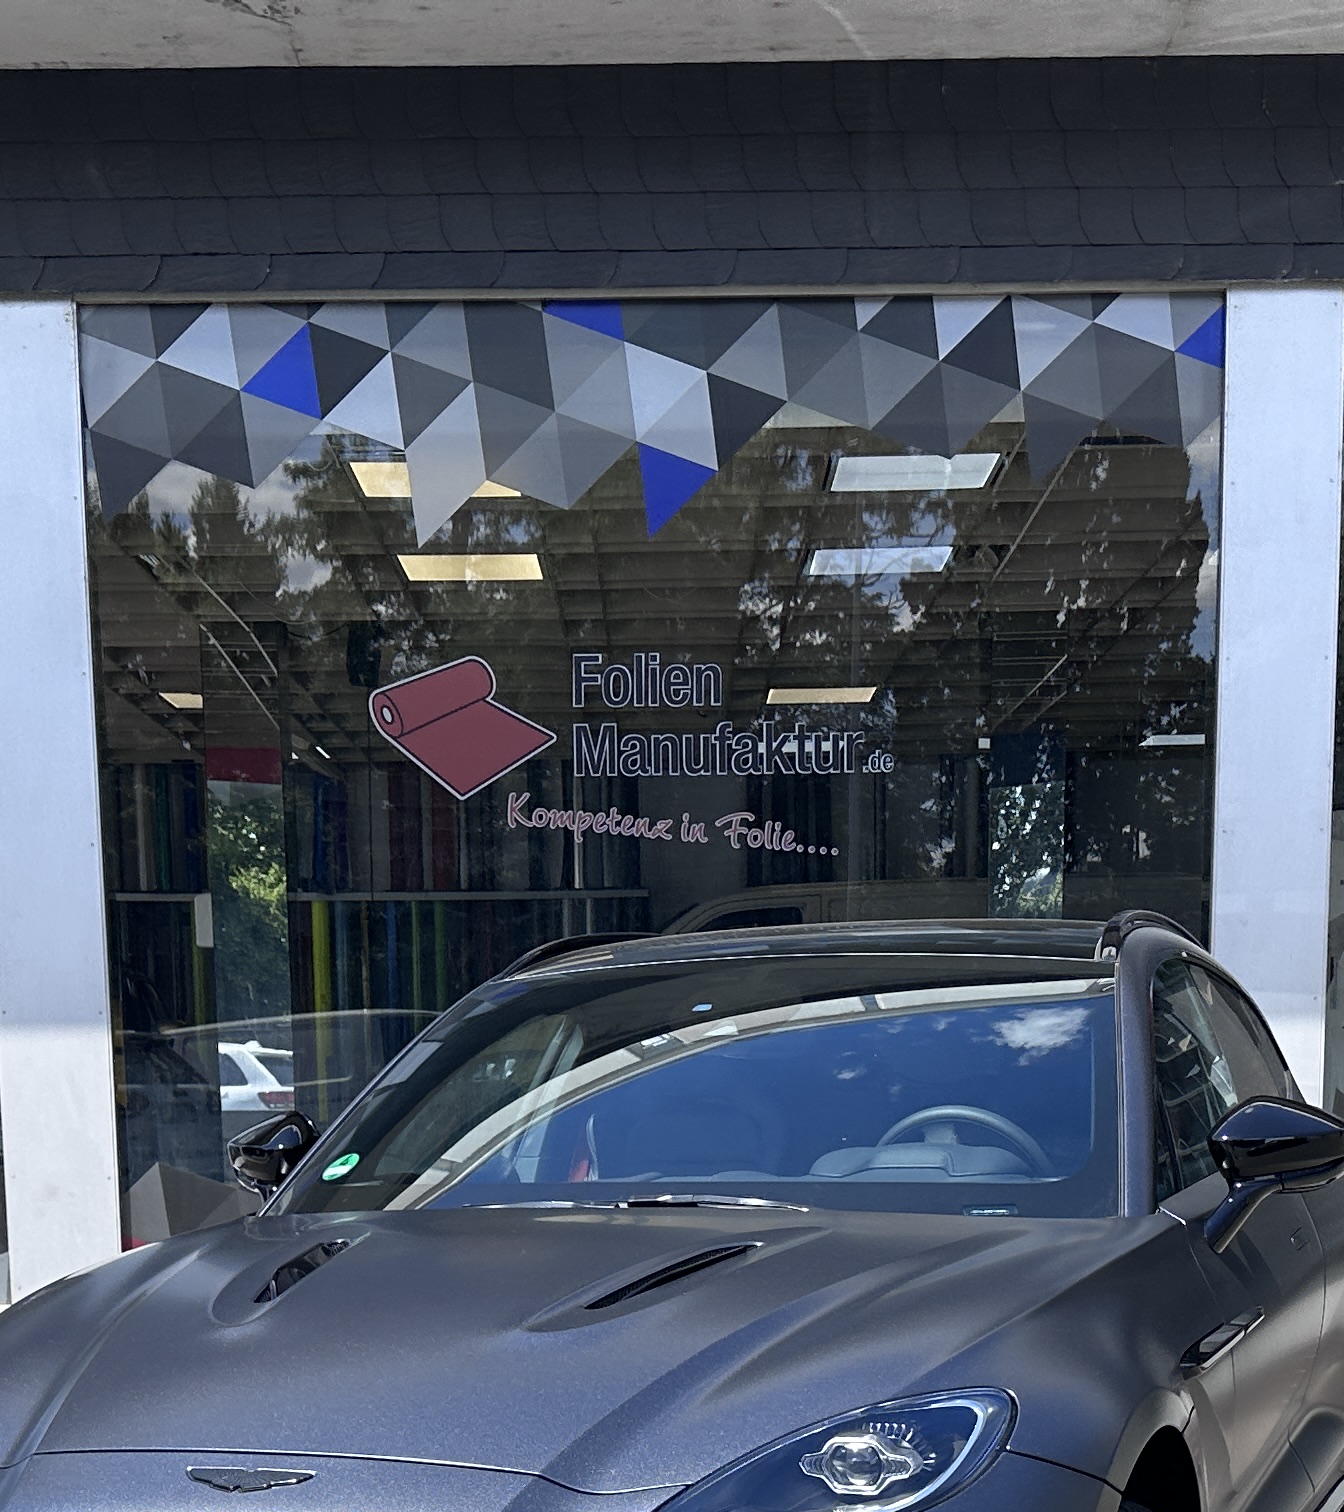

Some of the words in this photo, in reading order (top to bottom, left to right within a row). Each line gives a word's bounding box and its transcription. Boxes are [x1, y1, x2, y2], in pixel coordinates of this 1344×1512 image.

[572, 652, 723, 708] Folien
[572, 721, 895, 778] Manufaktur.de
[507, 792, 673, 843] Kompetenz
[681, 812, 709, 844] in
